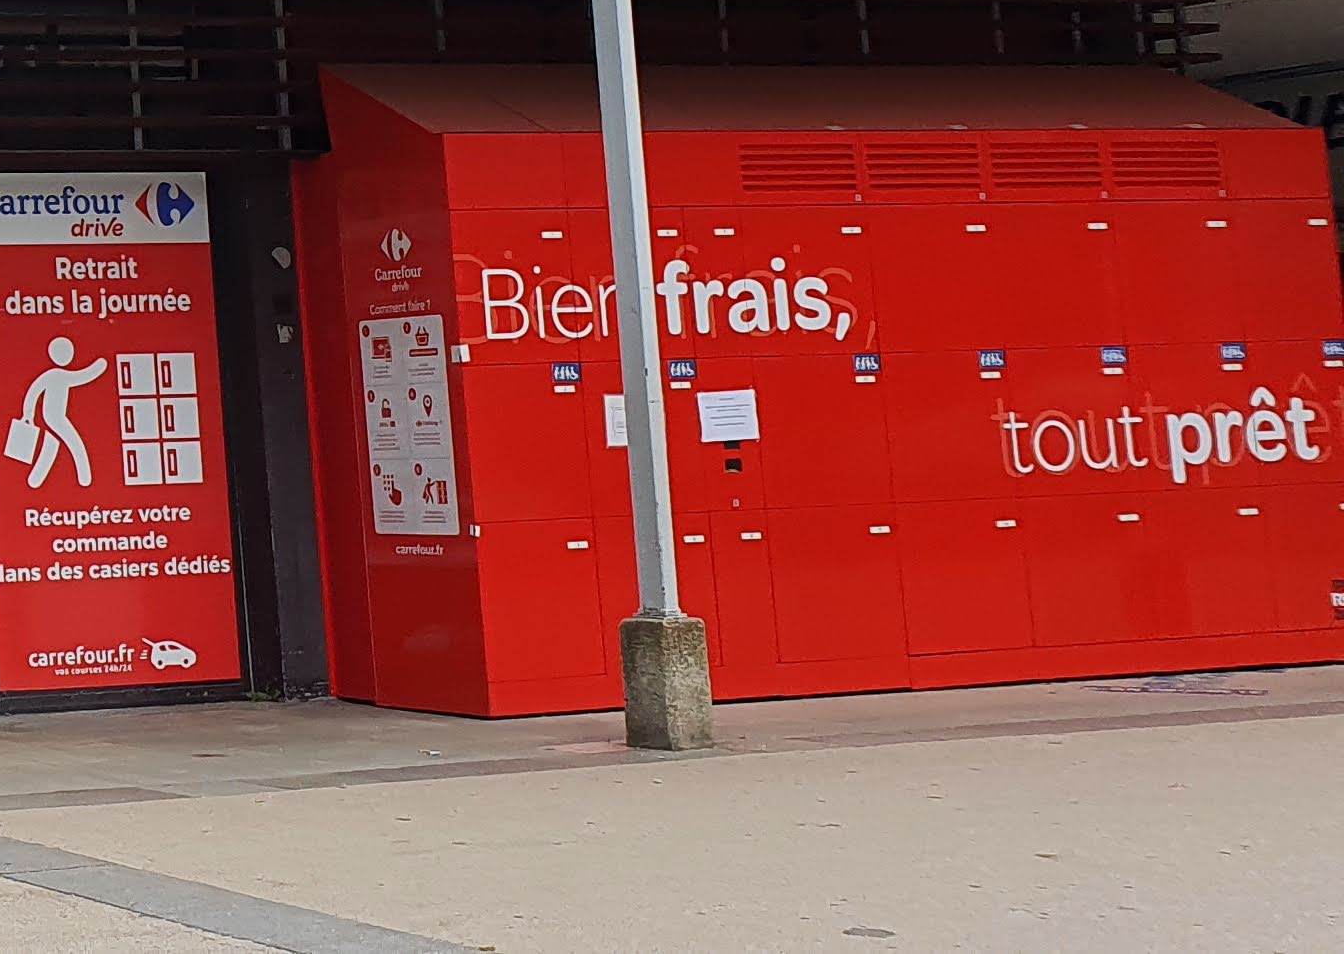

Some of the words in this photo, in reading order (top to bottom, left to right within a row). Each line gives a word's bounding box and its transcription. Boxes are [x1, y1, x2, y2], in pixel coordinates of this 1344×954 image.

[71, 217, 124, 237] drive
[55, 255, 138, 279] Retrait
[374, 265, 422, 281] Carrefour
[5, 290, 64, 315] dans
[71, 289, 93, 313] la
[98, 288, 191, 319] journée
[657, 257, 851, 341] frais,
[1002, 406, 1149, 473] tout
[1165, 386, 1320, 484] prêt
[25, 505, 133, 529] Récupérez
[138, 504, 191, 523] votre
[52, 531, 168, 553] commande
[47, 562, 83, 580] des
[88, 559, 159, 579] casiers
[164, 555, 231, 576] dédiés
[28, 643, 134, 668] carrefour.fr
[55, 668, 69, 676] vos
[71, 666, 102, 675] courses
